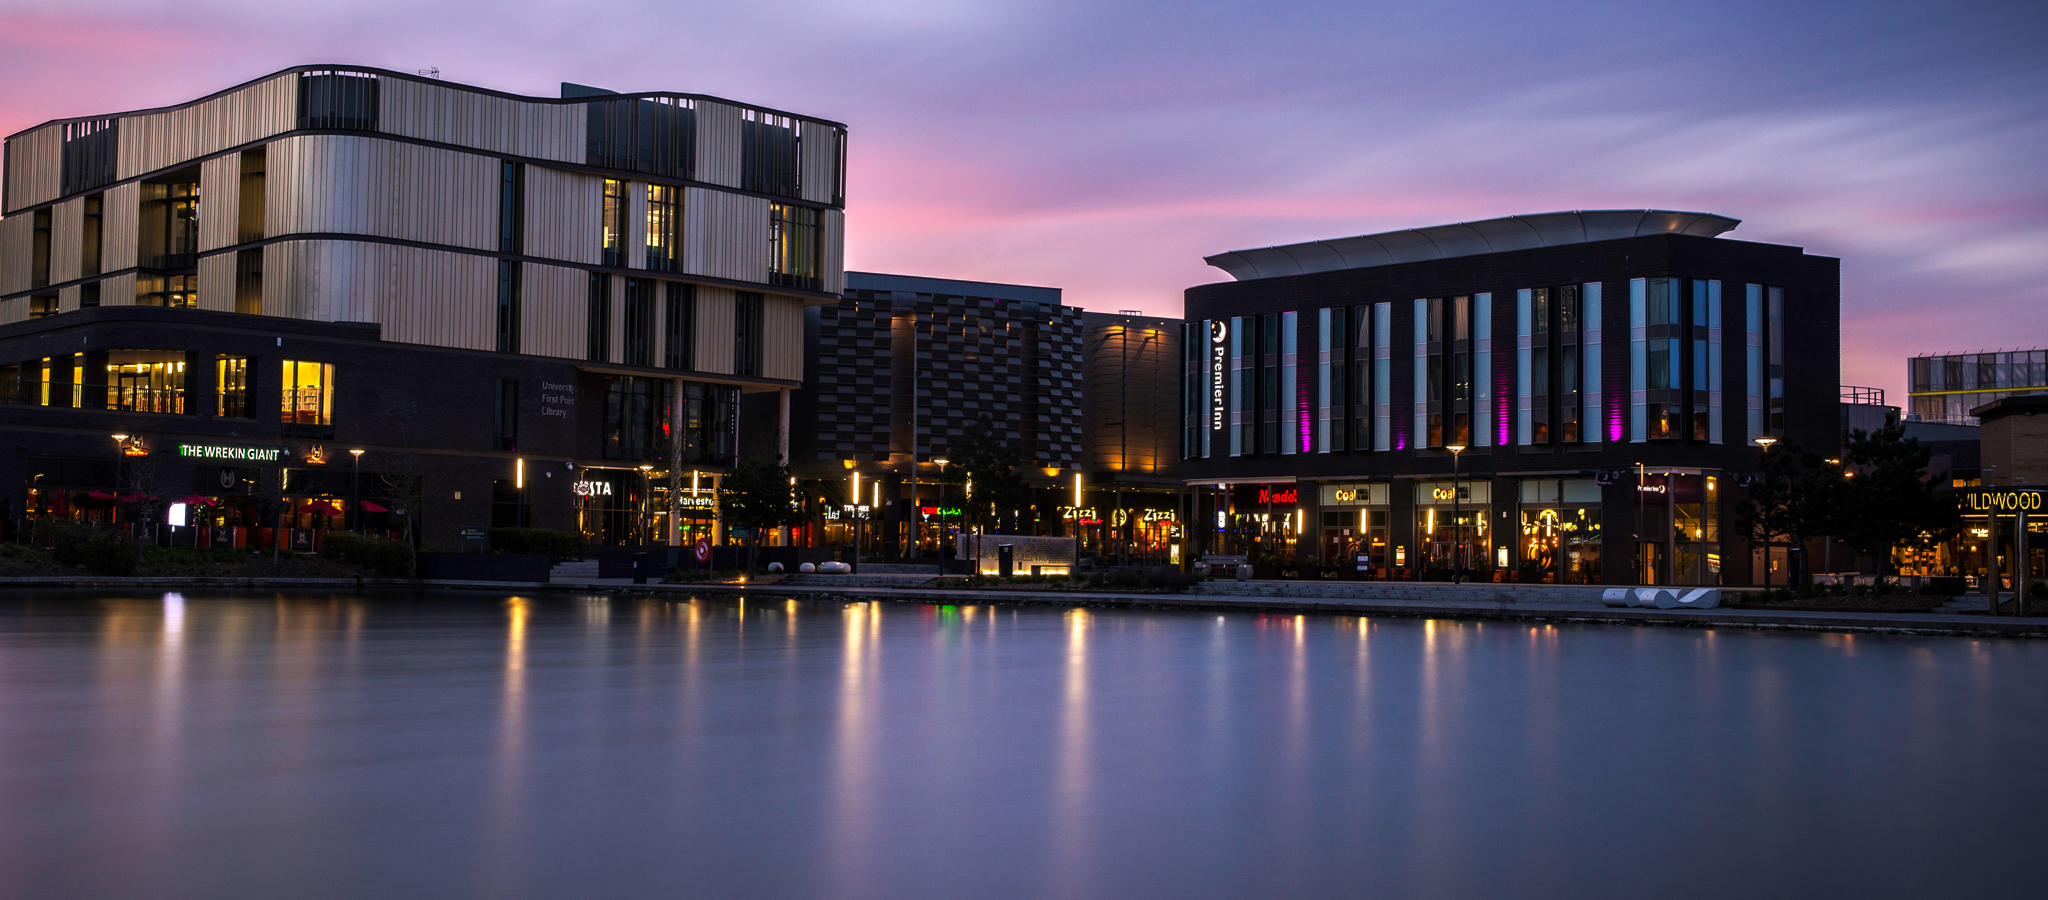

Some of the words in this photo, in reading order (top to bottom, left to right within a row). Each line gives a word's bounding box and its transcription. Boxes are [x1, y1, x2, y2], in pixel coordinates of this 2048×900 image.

[1214, 347, 1224, 405] Premier
[542, 381, 575, 395] University
[542, 394, 559, 404] First
[541, 407, 567, 419] Library
[1214, 407, 1224, 430] Inn
[182, 444, 202, 458] THE
[204, 446, 246, 459] WREKIN
[247, 448, 279, 461] GIANT
[573, 480, 612, 497] CSTA
[1336, 489, 1357, 501] Coal
[1433, 487, 1456, 500] Coal
[1063, 506, 1097, 519] Zizzi
[1143, 508, 1176, 522] Zizzi
